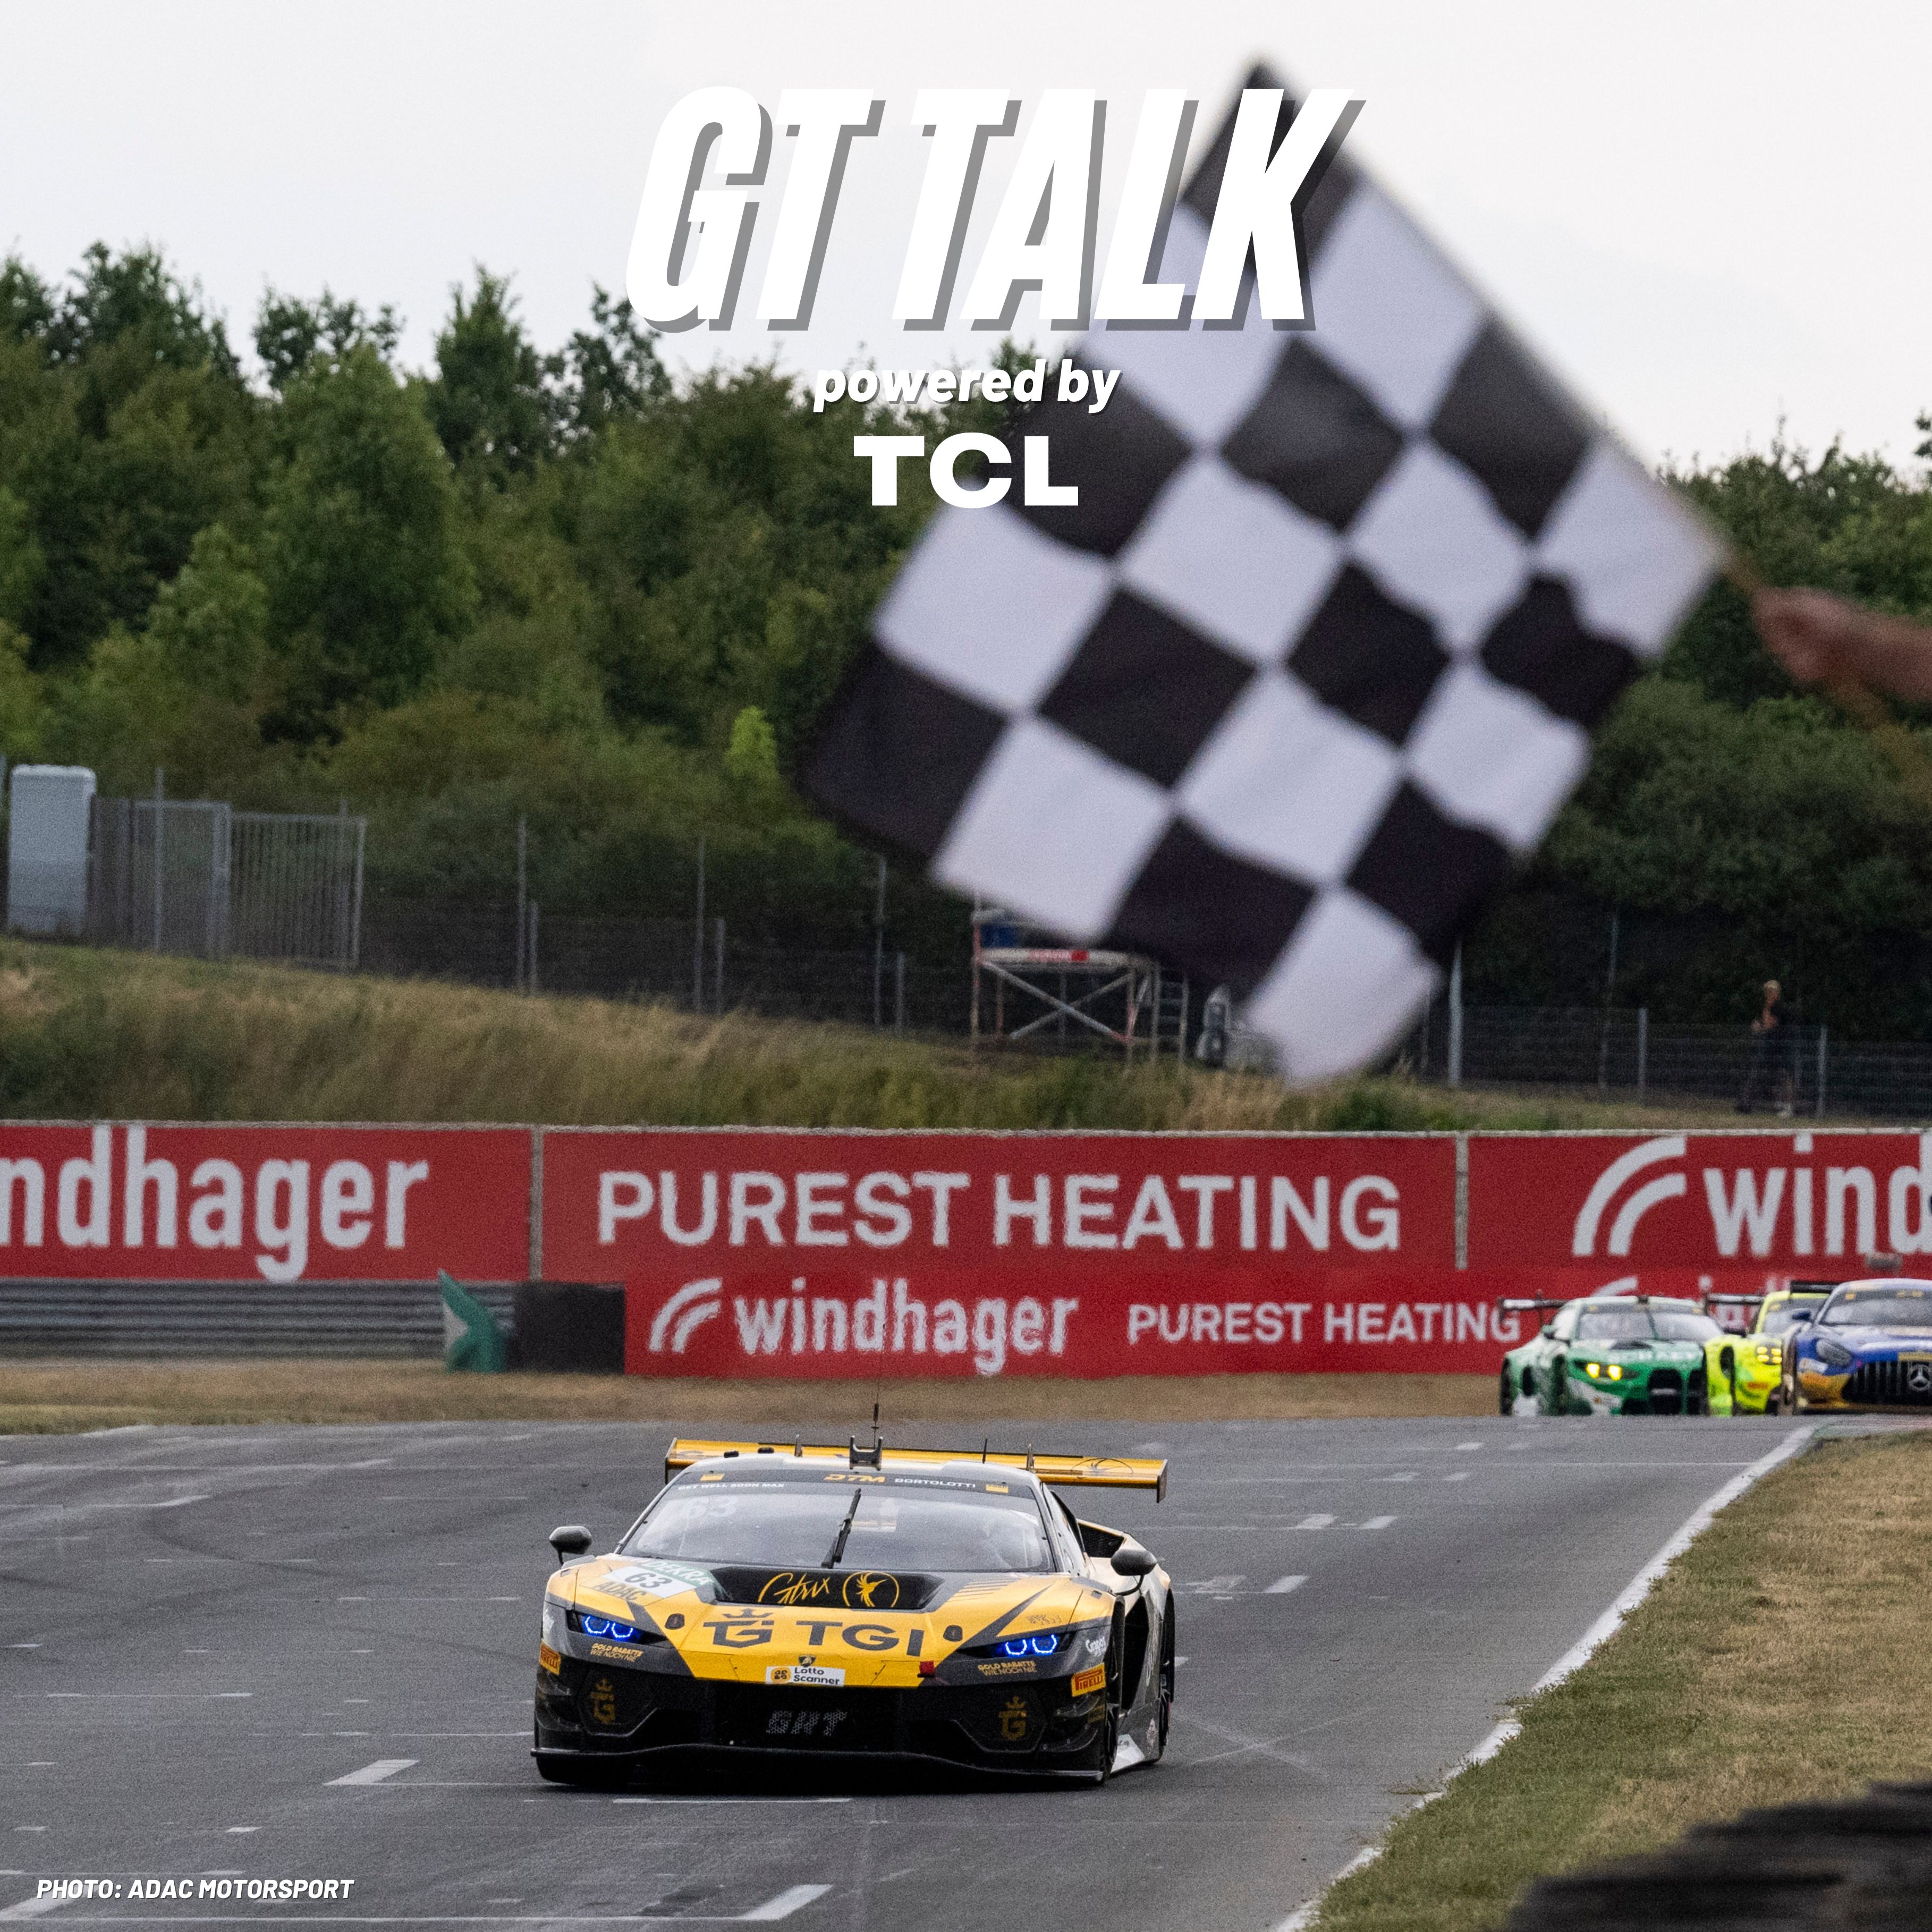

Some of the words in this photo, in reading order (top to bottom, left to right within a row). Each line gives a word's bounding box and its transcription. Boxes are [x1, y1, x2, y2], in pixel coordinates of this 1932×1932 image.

[598, 1171, 970, 1248] PUREST
[994, 1174, 1401, 1251] HEATING
[734, 1277, 1079, 1377] windhager
[1128, 1302, 1311, 1345] PUREST
[1324, 1302, 1520, 1343] HEATING
[824, 1474, 886, 1483] DTM
[895, 1478, 976, 1488] BORTOLOTTI
[624, 1572, 673, 1589] 63
[641, 1558, 714, 1586] DEKRA
[594, 1581, 648, 1601] ADAC
[795, 1620, 925, 1657] TGI
[590, 1648, 603, 1657] WIE
[603, 1650, 624, 1660] NOCH
[793, 1674, 841, 1685] Scanner
[794, 1667, 825, 1675] Lotto
[1074, 1668, 1104, 1691] PIRELLI
